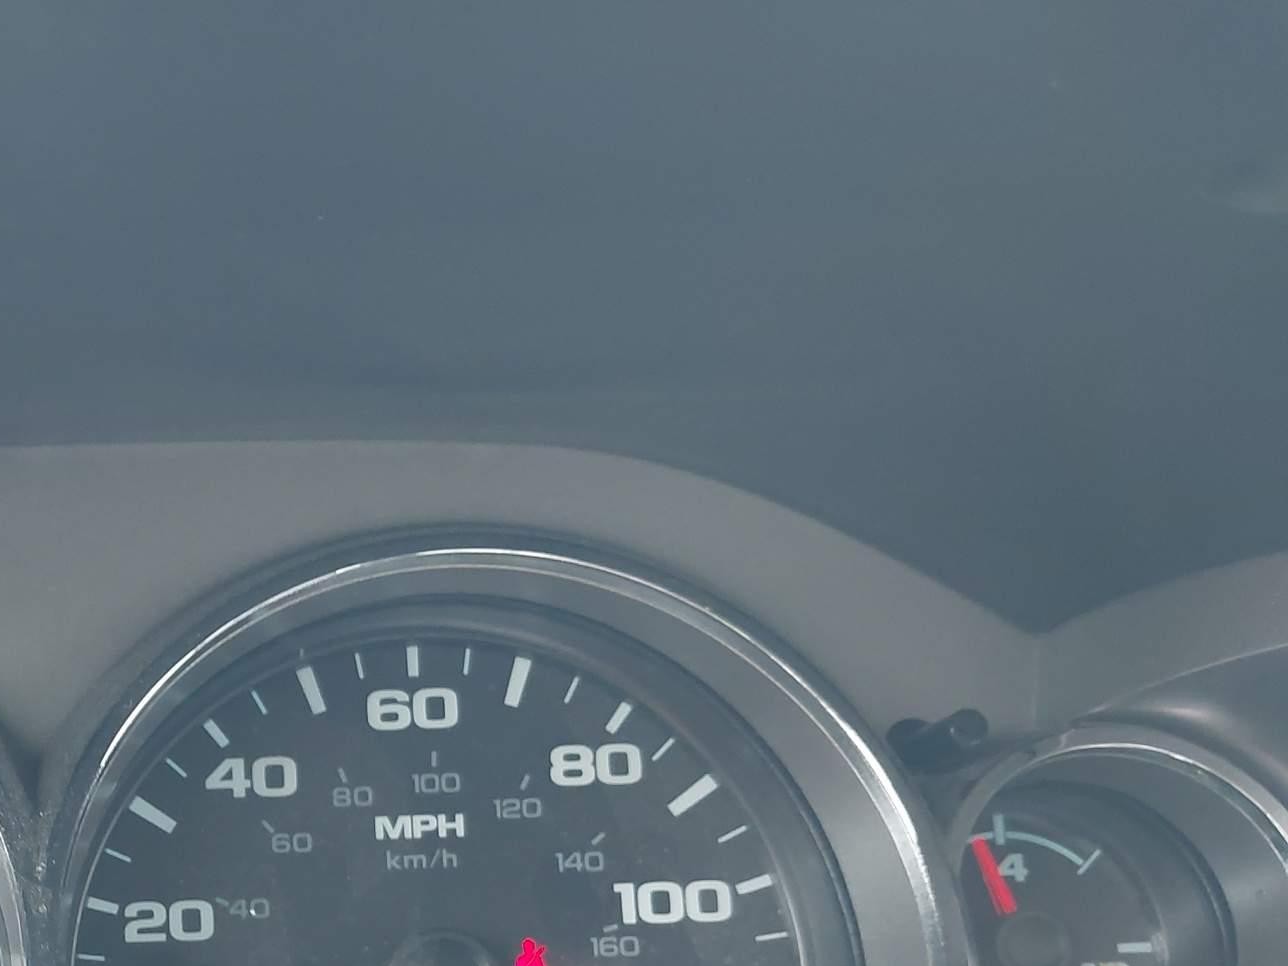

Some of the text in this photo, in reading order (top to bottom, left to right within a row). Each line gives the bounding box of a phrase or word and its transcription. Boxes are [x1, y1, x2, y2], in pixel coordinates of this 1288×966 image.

[366, 687, 459, 731] 60
[549, 743, 643, 786] 80
[205, 756, 298, 798] 40
[412, 773, 461, 793] 100
[333, 787, 373, 808] 80
[493, 798, 542, 819] 120
[374, 813, 465, 840] MPH
[271, 832, 313, 853] 60
[386, 850, 458, 870] km/h
[555, 852, 604, 872] 140
[229, 898, 270, 919] 40
[613, 880, 732, 925] 100
[124, 900, 215, 943] 20
[590, 936, 640, 957] 160
